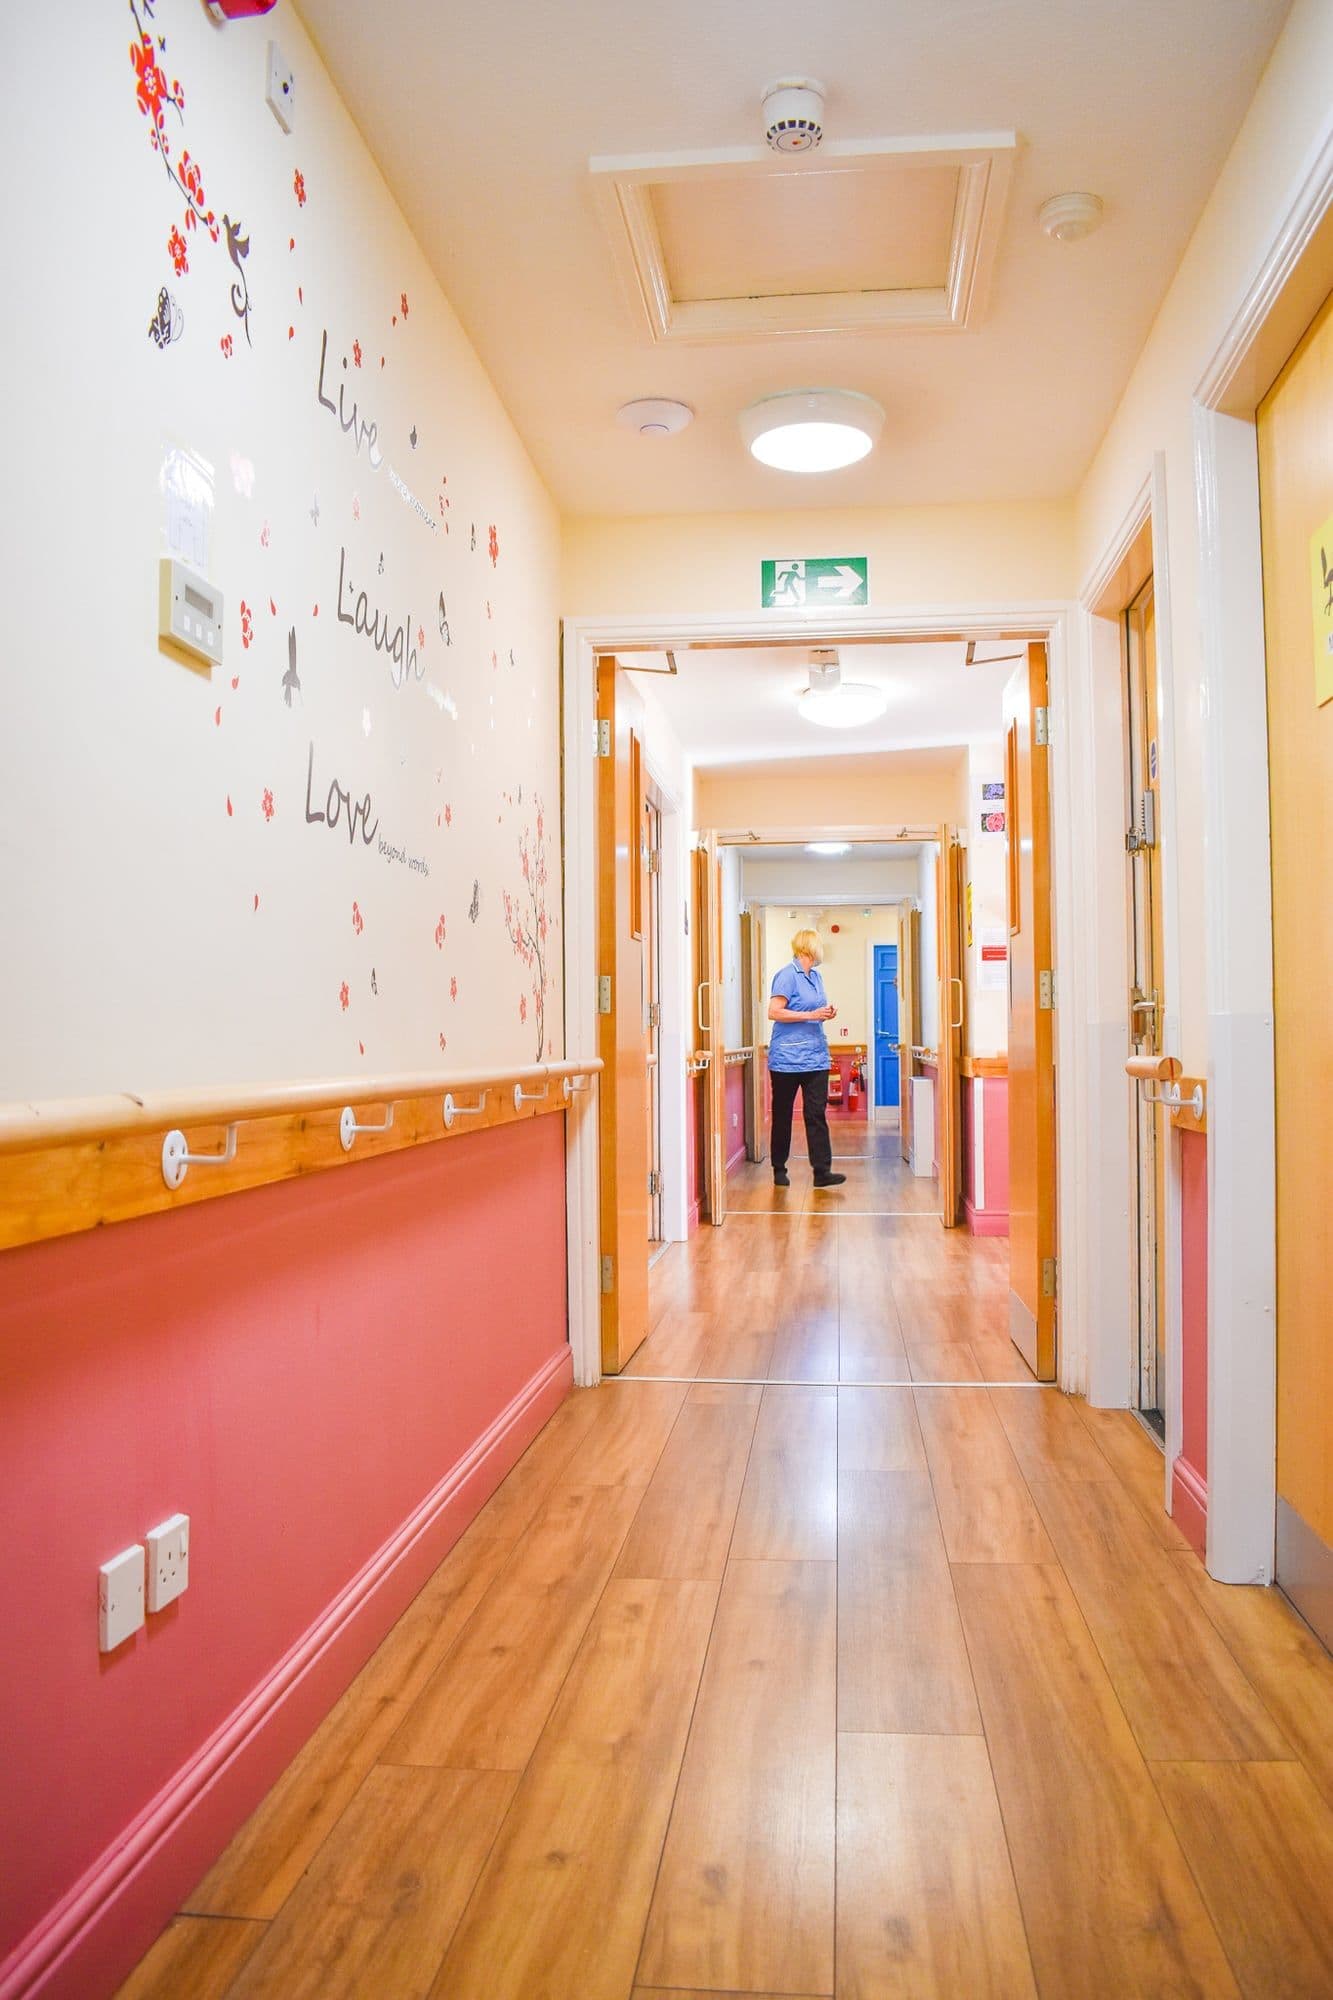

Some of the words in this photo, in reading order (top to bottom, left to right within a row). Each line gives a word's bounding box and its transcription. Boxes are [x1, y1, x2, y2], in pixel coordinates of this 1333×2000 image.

[318, 329, 384, 470] Live
[337, 546, 426, 690] Laugh
[305, 740, 379, 846] Love
[378, 831, 407, 864] beyond
